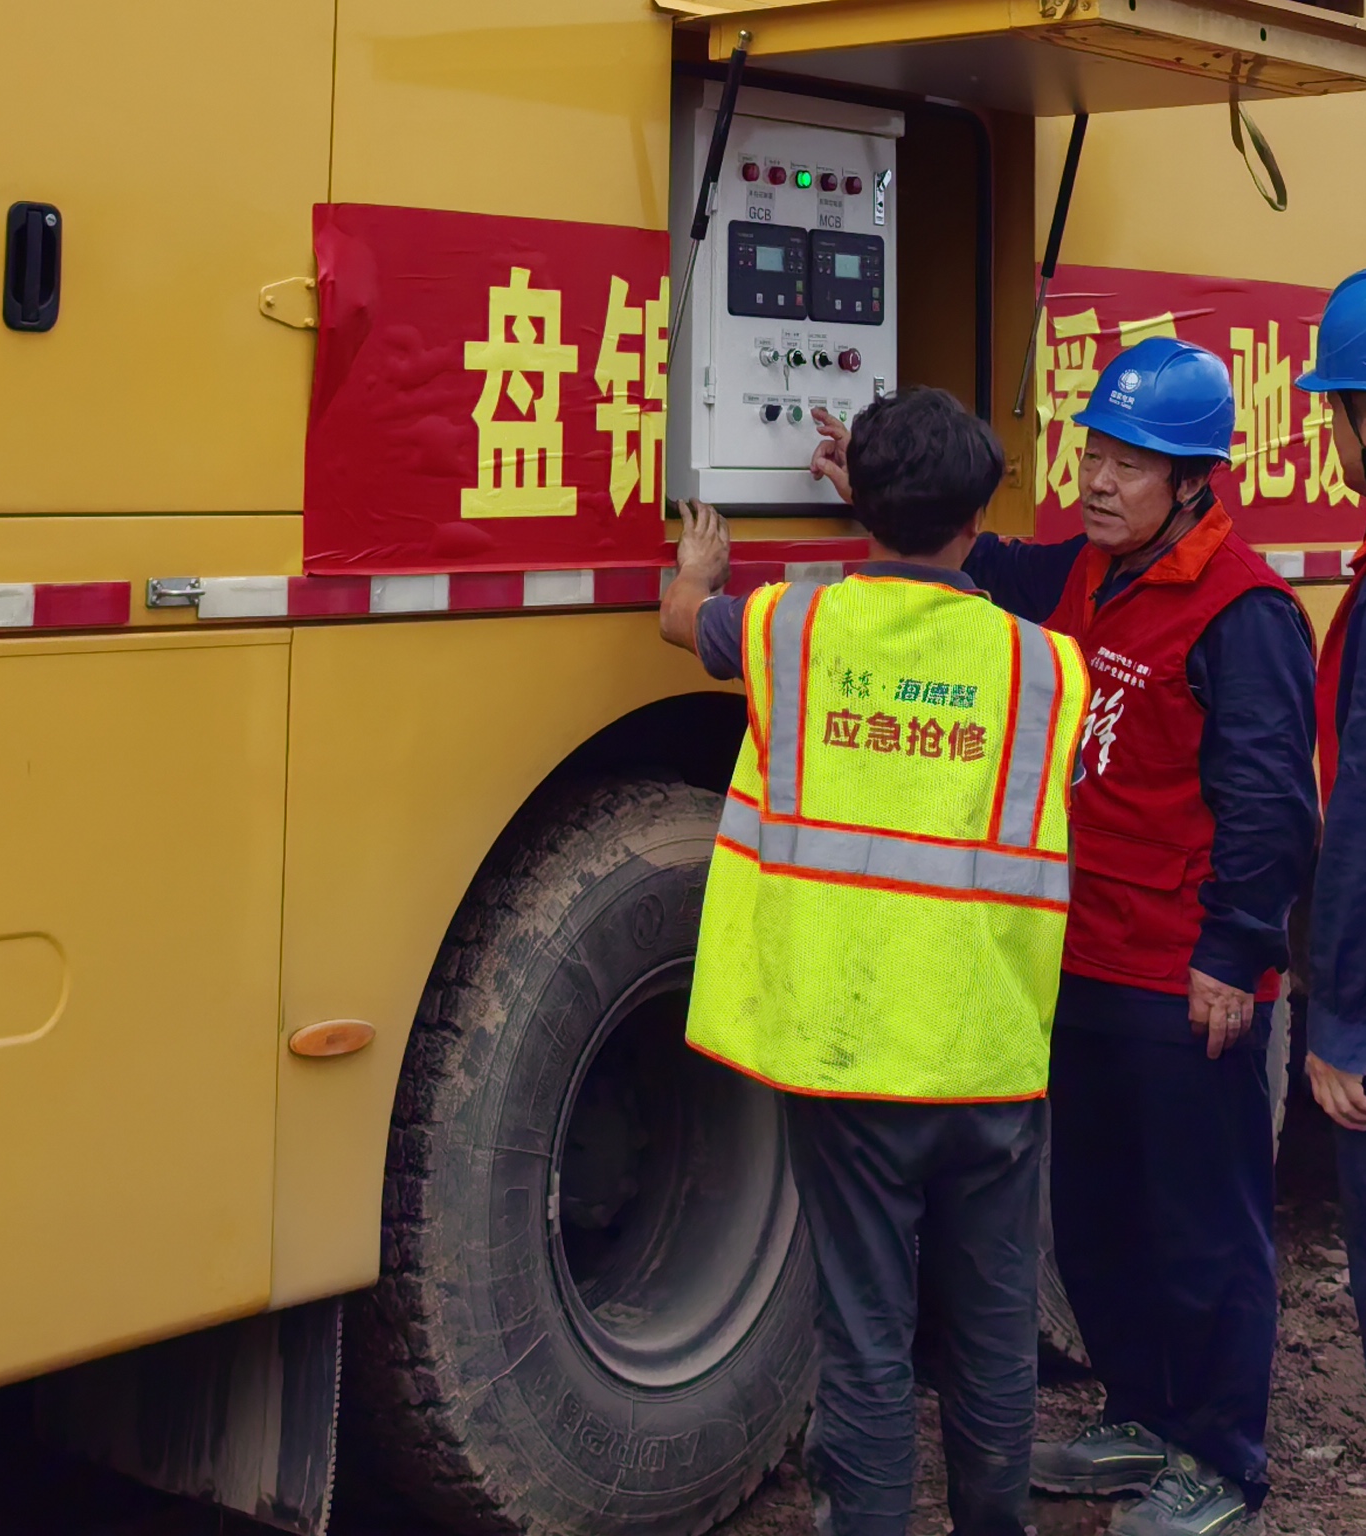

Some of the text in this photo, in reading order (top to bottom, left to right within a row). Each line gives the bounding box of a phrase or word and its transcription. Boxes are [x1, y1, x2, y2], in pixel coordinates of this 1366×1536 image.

[748, 206, 772, 222] GCB
[819, 215, 842, 229] MCB
[823, 708, 987, 763] 应急抢修
